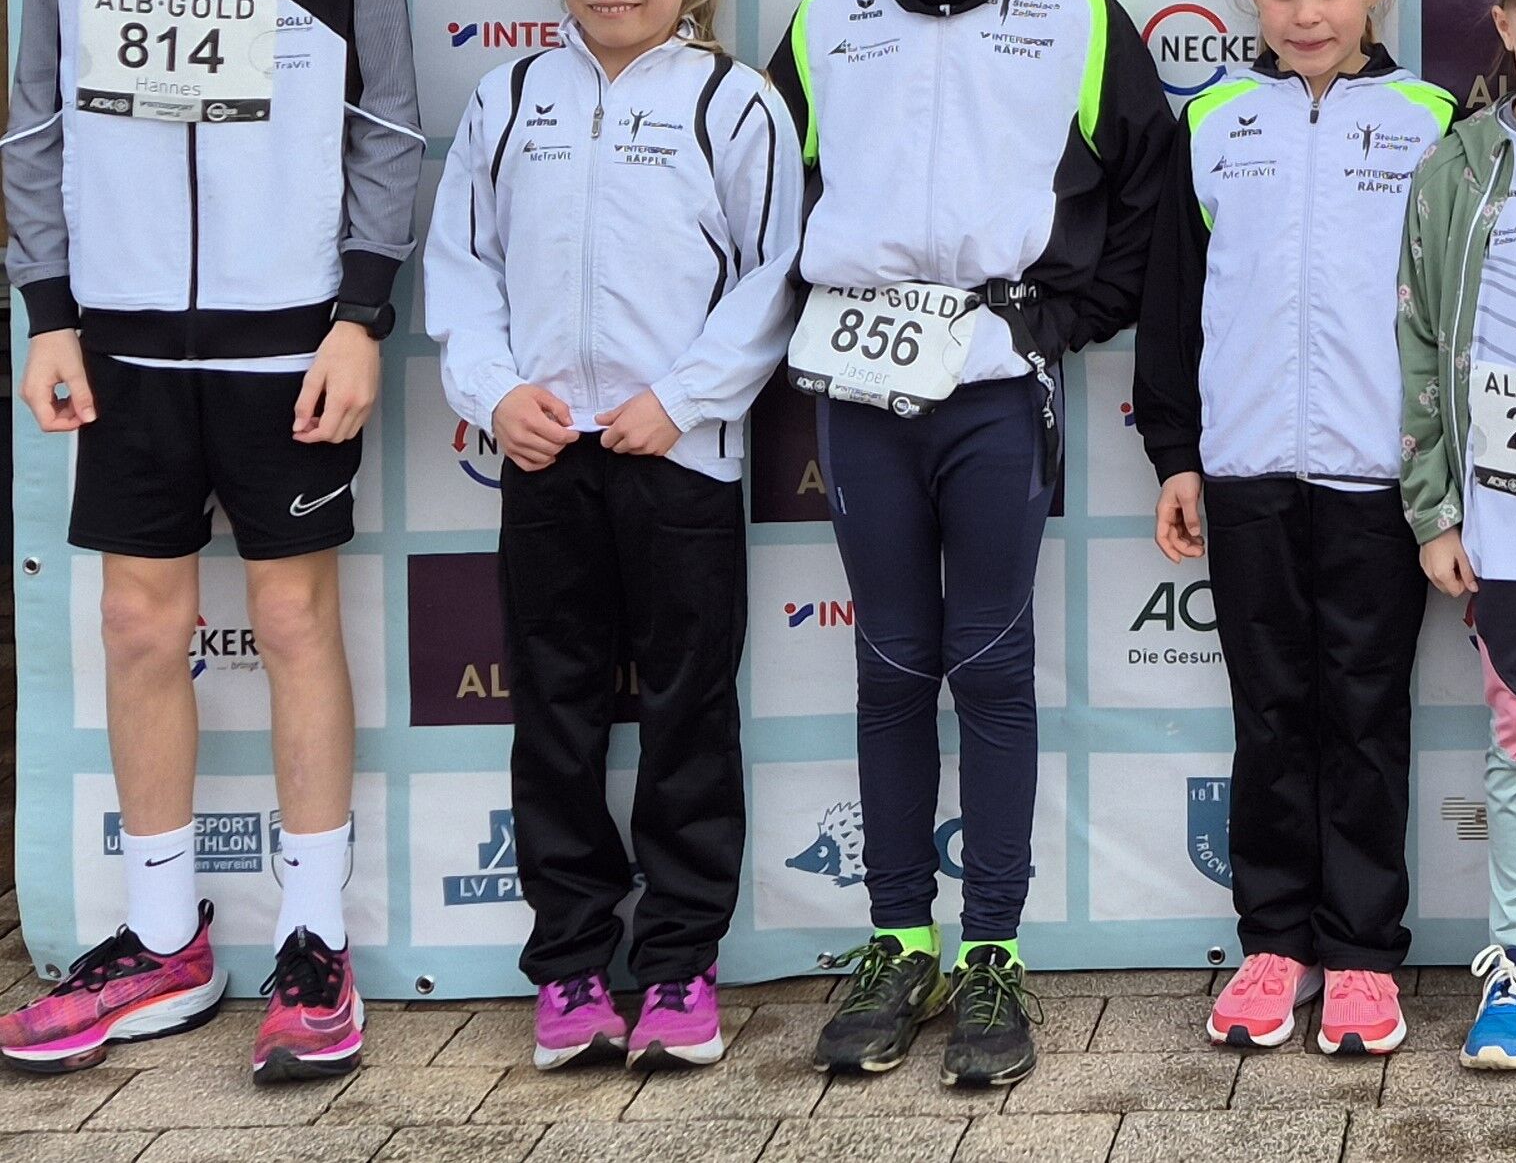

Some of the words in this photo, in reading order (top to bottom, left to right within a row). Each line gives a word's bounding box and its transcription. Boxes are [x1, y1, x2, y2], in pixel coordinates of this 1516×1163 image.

[276, 16, 314, 28] OGLU
[849, 8, 883, 22] erima
[117, 21, 225, 74] 814
[1161, 35, 1257, 64] NECKE
[135, 76, 201, 97] Hannes
[1229, 127, 1263, 139] erima
[830, 308, 923, 367] 856
[838, 361, 891, 386] Jasper
[1128, 649, 1160, 666] Die
[213, 856, 258, 871] vereint
[459, 878, 488, 898] LV
